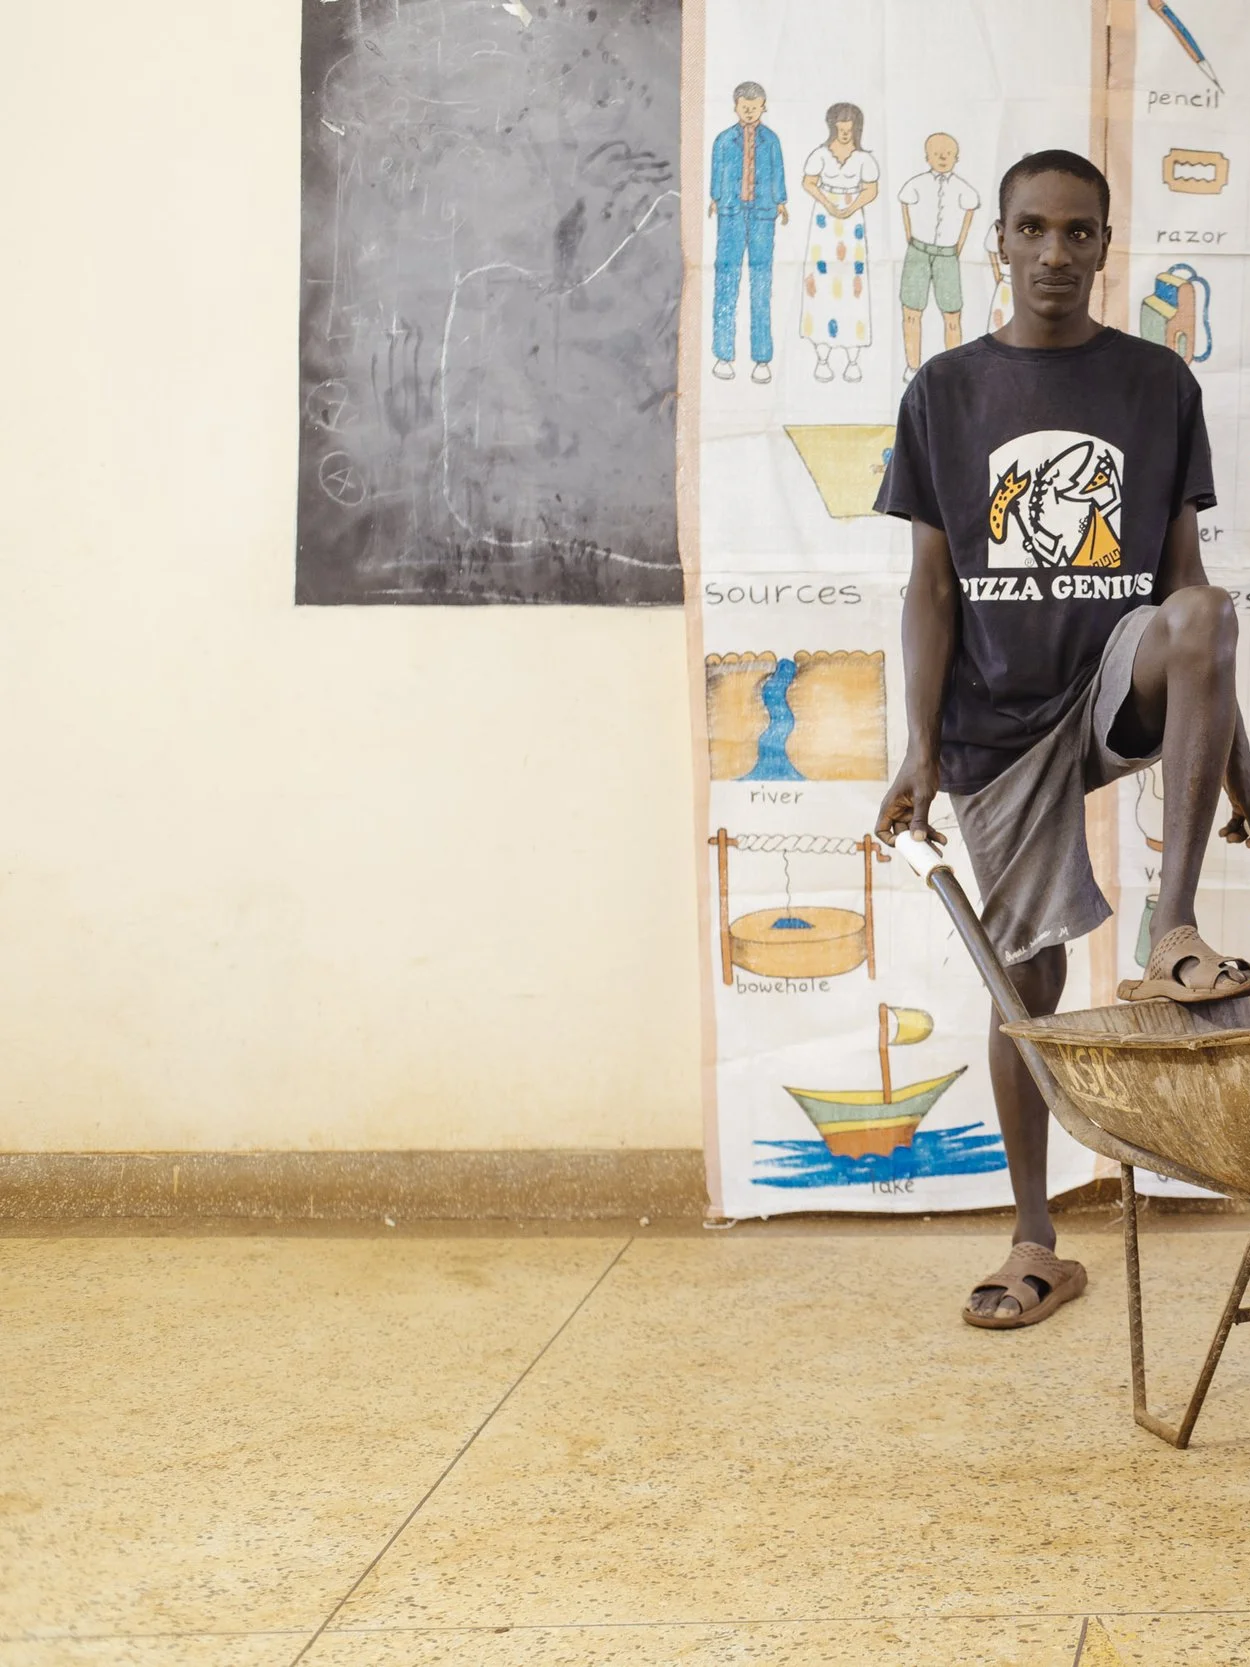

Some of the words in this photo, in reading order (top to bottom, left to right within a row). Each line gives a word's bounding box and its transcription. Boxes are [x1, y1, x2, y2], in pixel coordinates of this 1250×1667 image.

[1147, 90, 1220, 113] pencil
[1156, 228, 1227, 246] razor
[704, 582, 862, 605] sources
[1051, 572, 1154, 601] GENIUS
[750, 785, 804, 804] river
[736, 974, 831, 995] bowehole
[869, 1167, 915, 1195] lake
